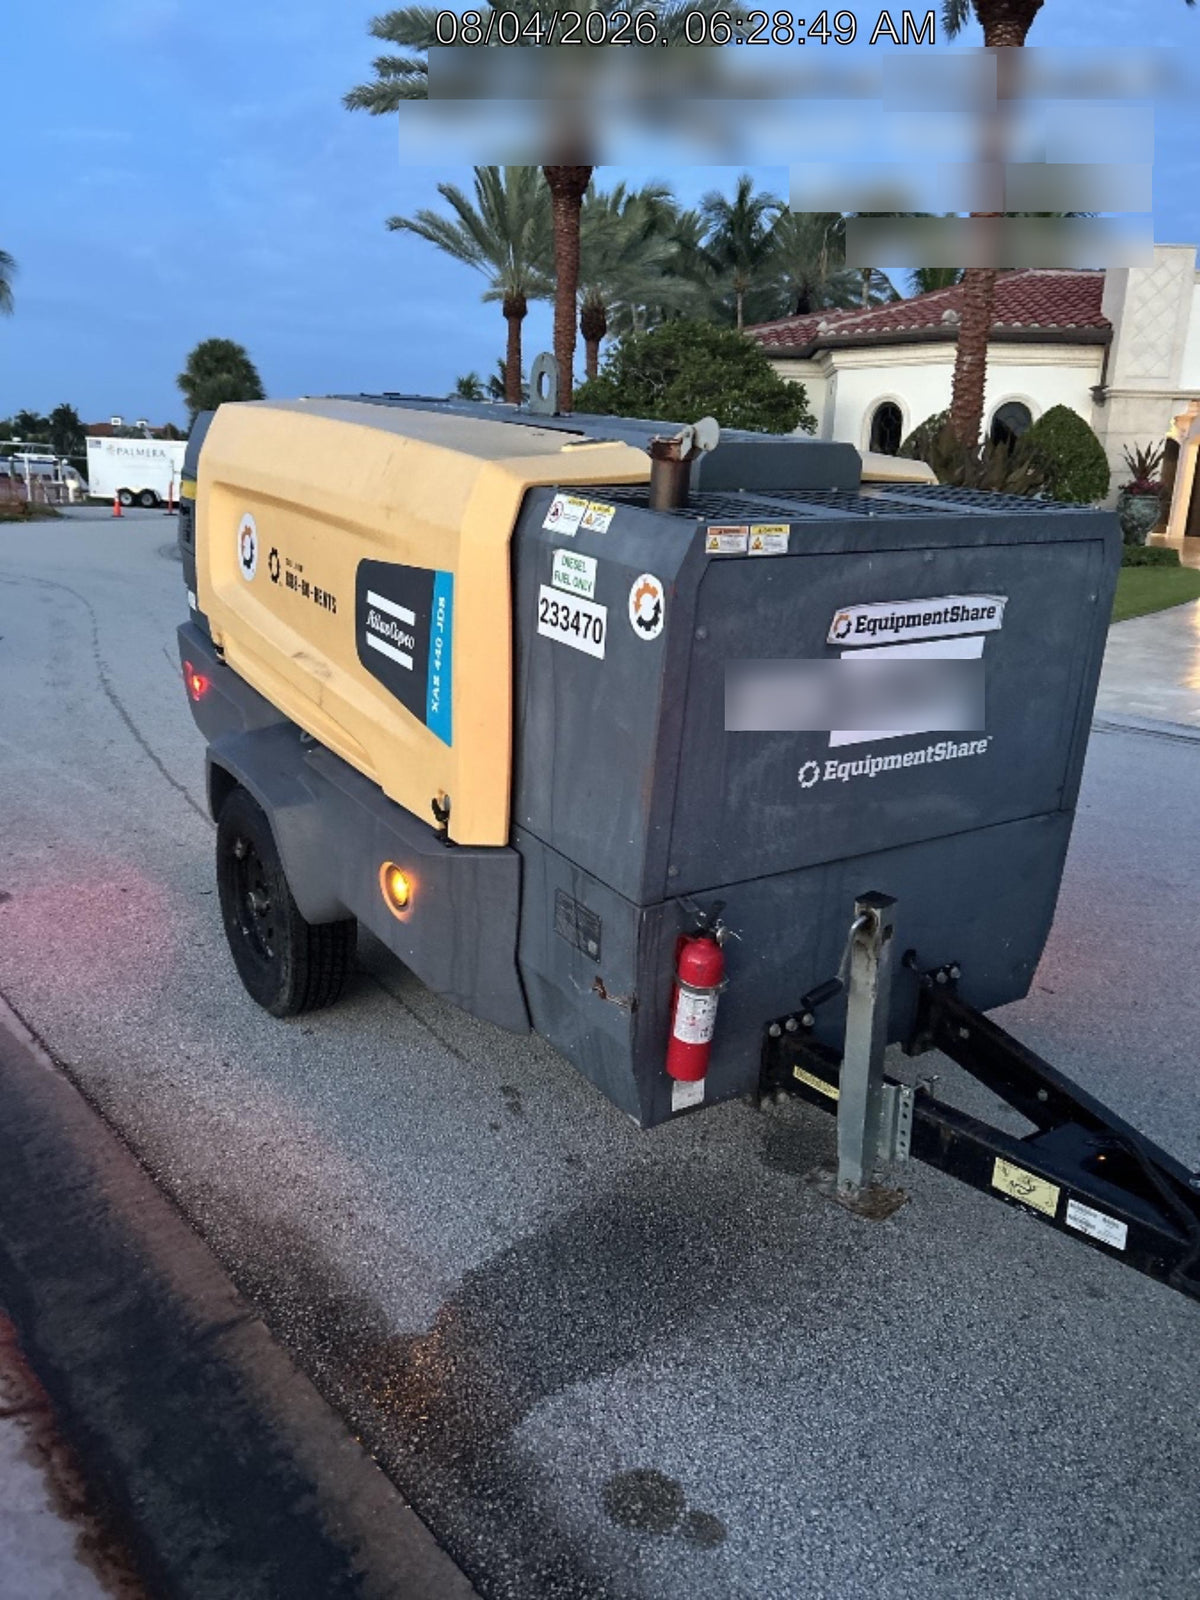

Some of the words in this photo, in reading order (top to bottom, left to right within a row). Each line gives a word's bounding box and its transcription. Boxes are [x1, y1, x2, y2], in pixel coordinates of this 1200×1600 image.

[561, 555, 587, 573] DIESEL
[554, 570, 571, 585] FUEL
[572, 576, 592, 592] ONLY
[540, 598, 604, 644] 233470
[854, 604, 997, 636] EquipmentShare
[823, 738, 989, 783] EquipmentShare
